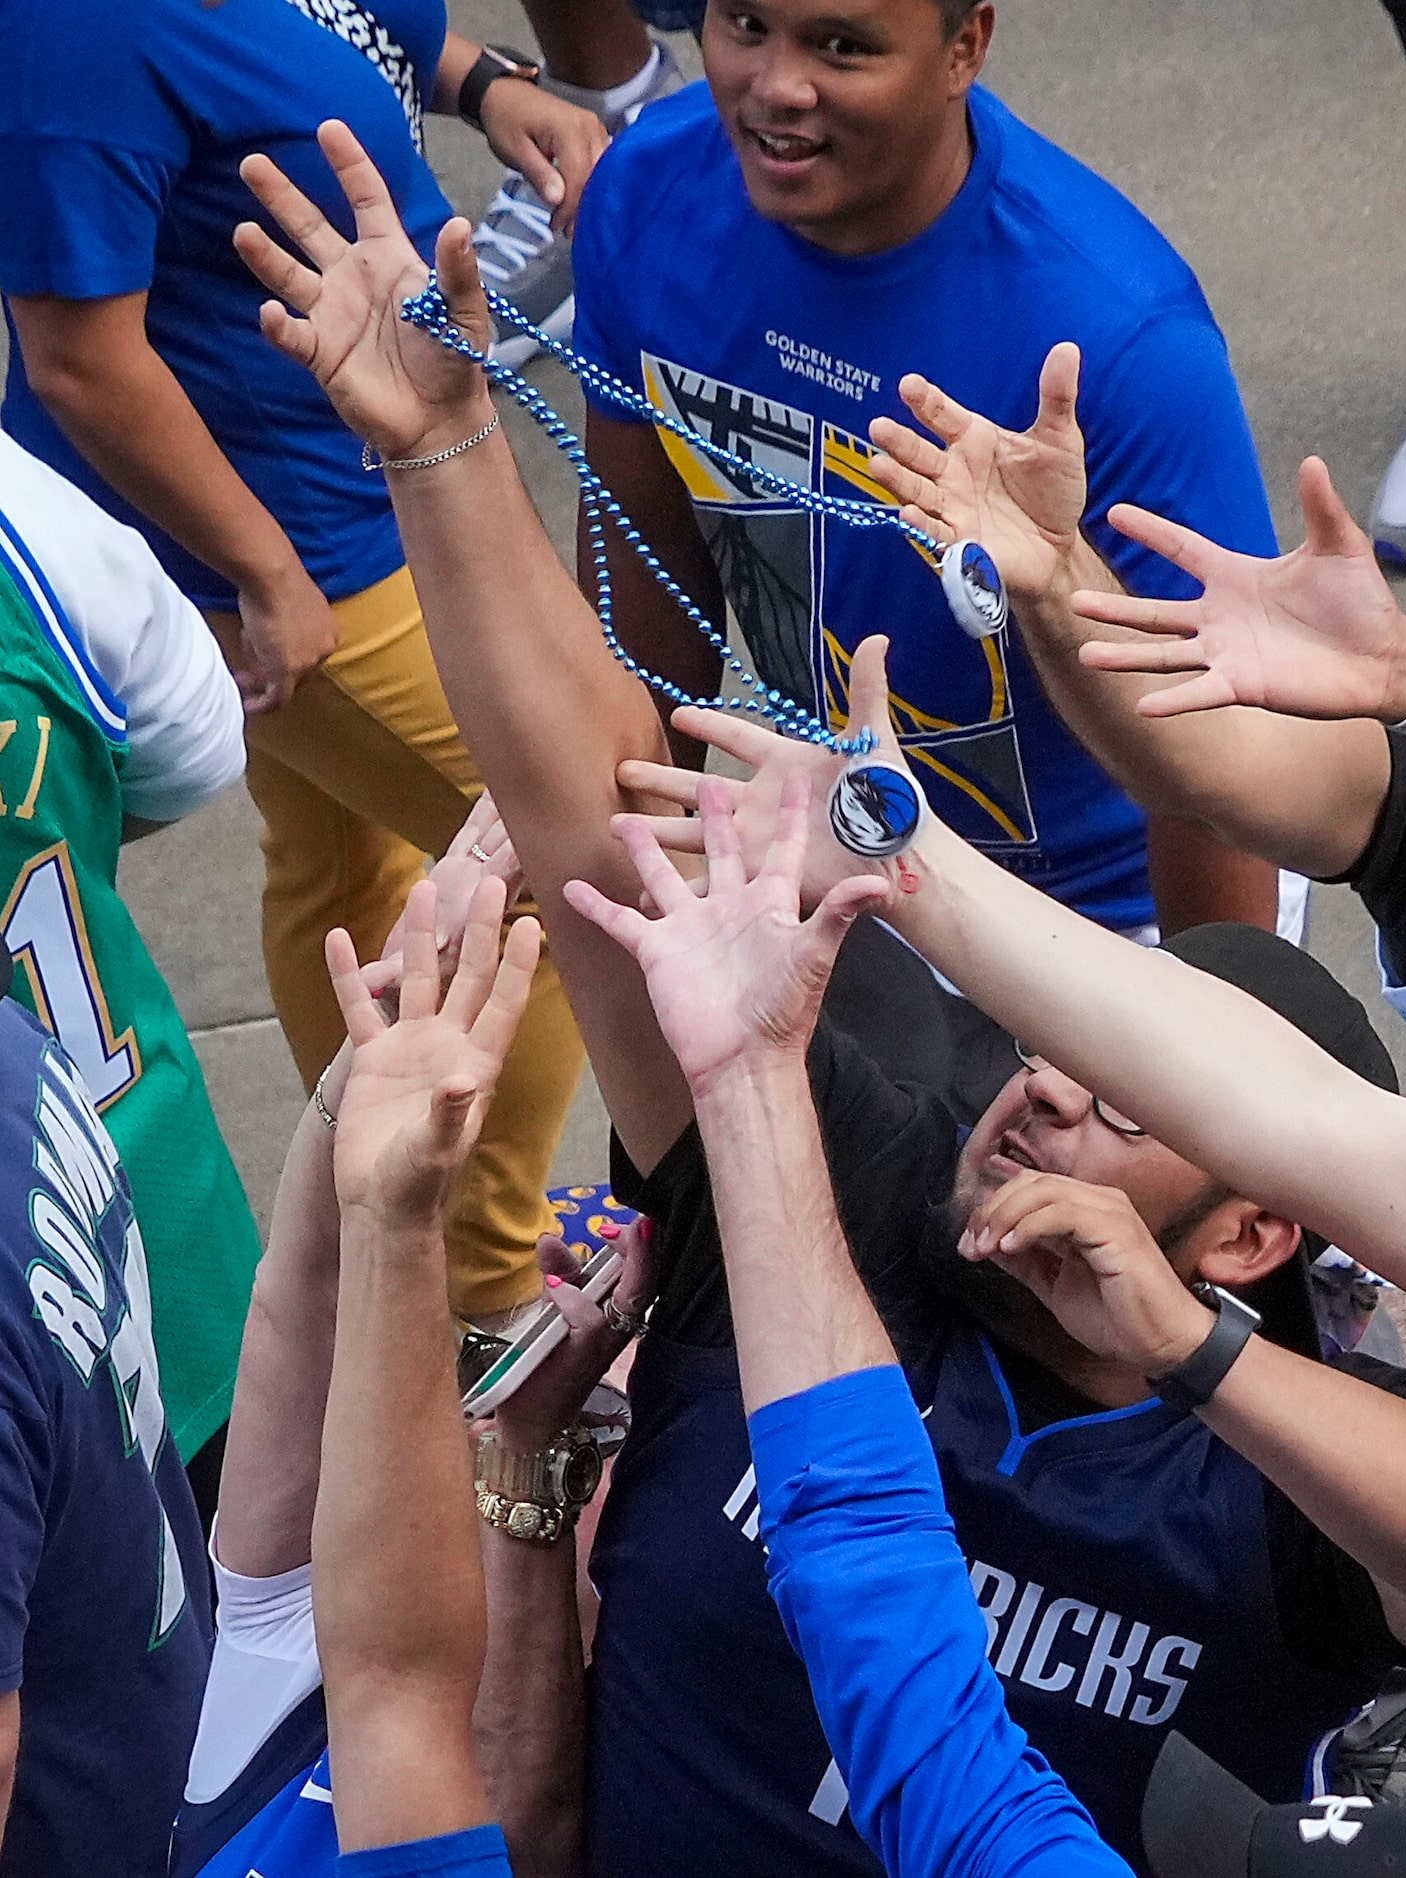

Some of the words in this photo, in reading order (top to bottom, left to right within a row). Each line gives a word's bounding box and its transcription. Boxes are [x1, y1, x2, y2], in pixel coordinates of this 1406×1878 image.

[765, 329, 832, 371] GOLDEN
[835, 360, 881, 393] STATE
[779, 353, 864, 401] WARRIORS
